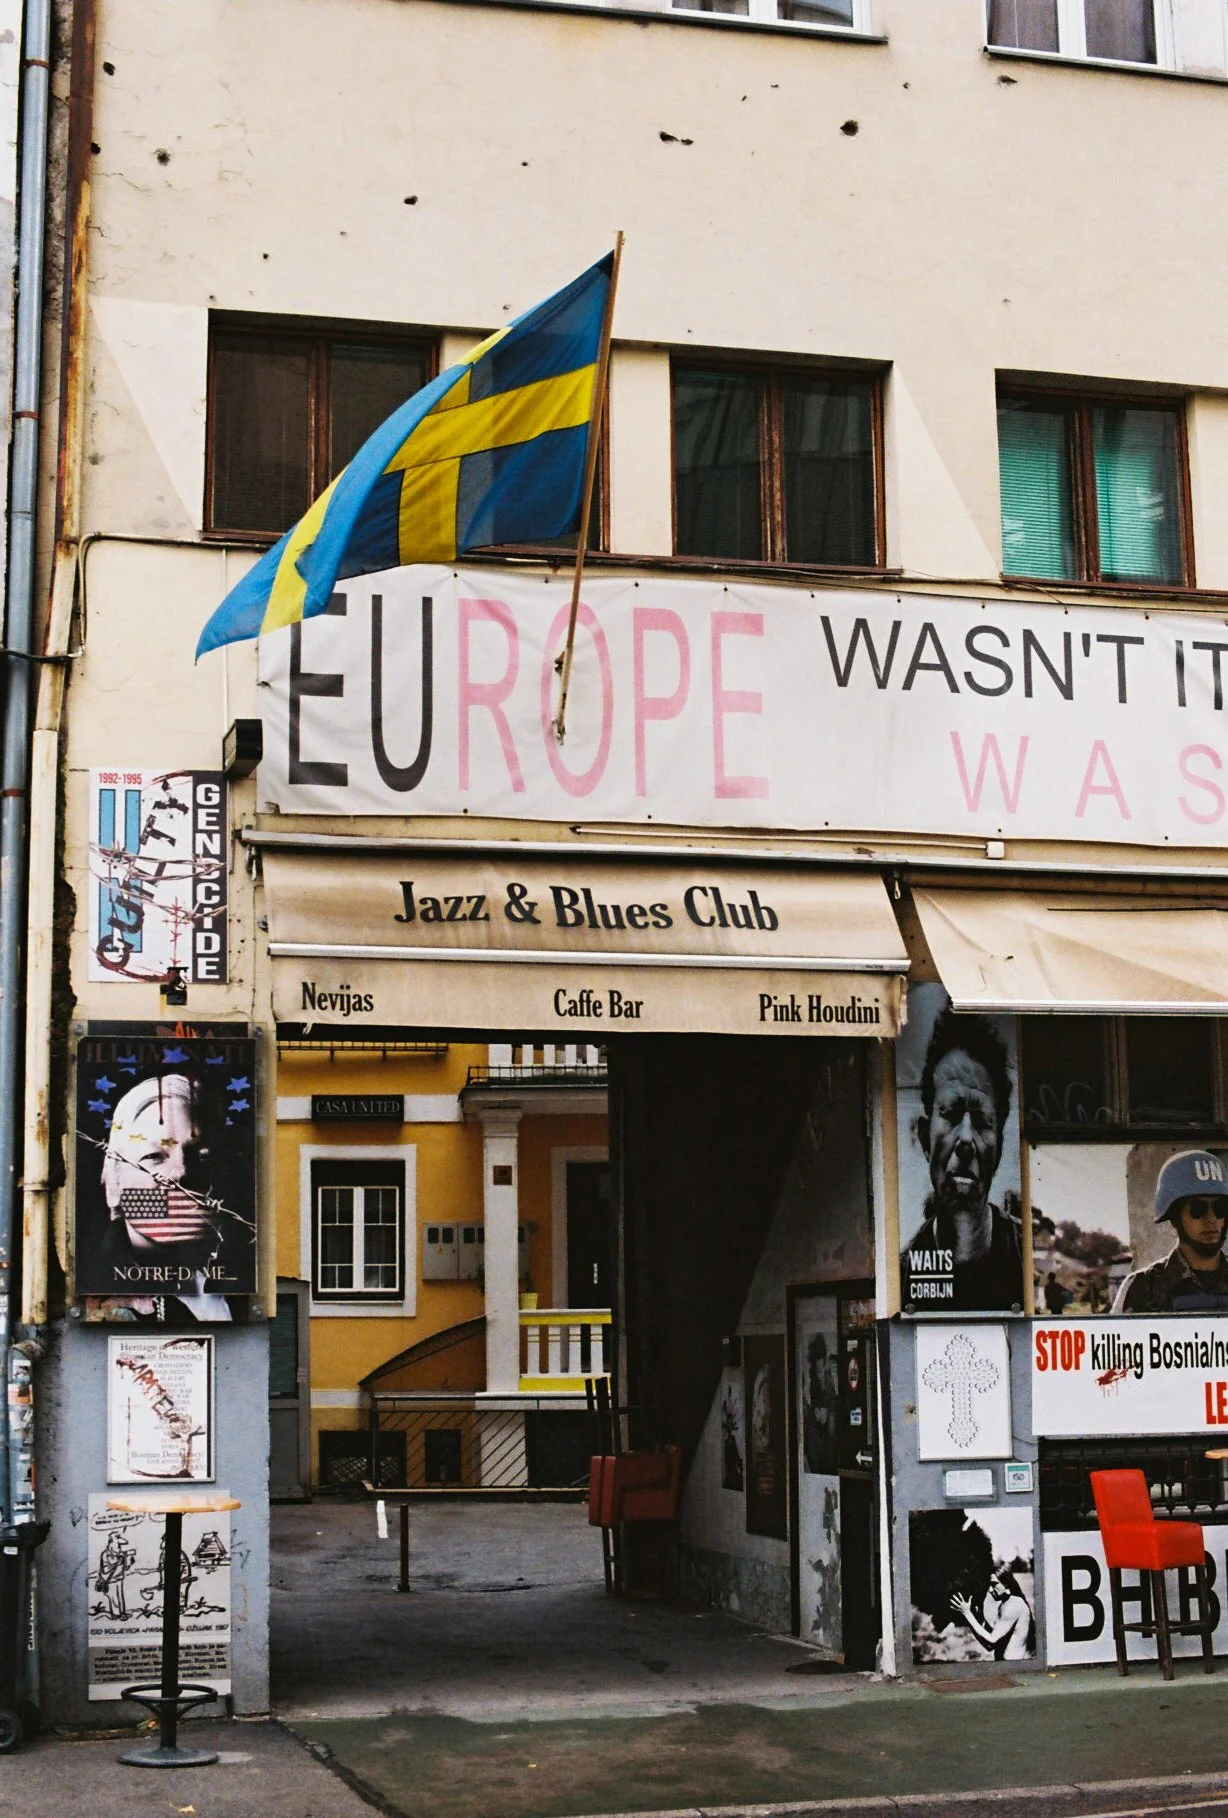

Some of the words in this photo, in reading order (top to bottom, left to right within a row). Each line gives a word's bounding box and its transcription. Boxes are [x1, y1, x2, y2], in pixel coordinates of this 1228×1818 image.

[820, 615, 1145, 704] WASN'T
[1175, 640, 1228, 711] IT
[288, 593, 770, 799] EUROPE
[98, 772, 142, 785] 1992-1995
[950, 731, 1226, 824] WAS
[196, 783, 220, 980] GENOCIDE
[394, 881, 490, 923] Jazz
[504, 882, 541, 924] &
[549, 885, 673, 929] Blues
[684, 885, 779, 931] Club
[301, 982, 374, 1017] Nevijas
[554, 988, 603, 1017] Caffe
[608, 990, 644, 1018] Bar
[759, 993, 802, 1022] Pink
[808, 994, 880, 1023] Houdini
[316, 1101, 348, 1113] CASA
[352, 1101, 400, 1113] UNITED
[1194, 1161, 1223, 1182] UN
[909, 1249, 953, 1271] WAITS
[910, 1282, 953, 1299] CORBIJN
[1036, 1330, 1086, 1371] STOP
[1091, 1334, 1143, 1379] killing
[1149, 1331, 1228, 1369] Bosnia/n
[1205, 1382, 1228, 1424] LE
